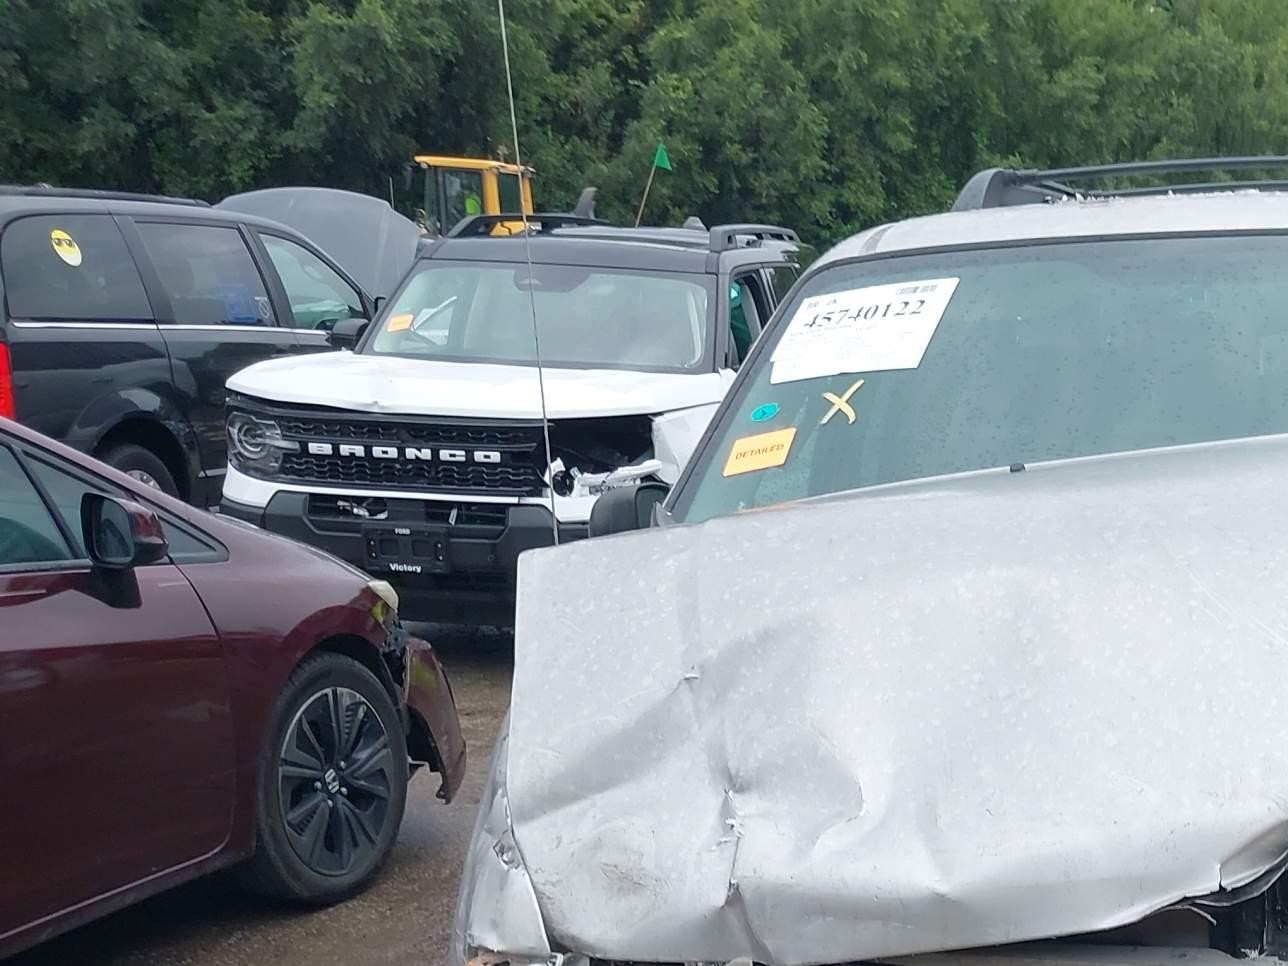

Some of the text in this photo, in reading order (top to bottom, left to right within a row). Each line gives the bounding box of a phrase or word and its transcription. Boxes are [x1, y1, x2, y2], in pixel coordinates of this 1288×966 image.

[803, 299, 926, 328] 45740122
[308, 442, 502, 464] BRONCO
[735, 443, 785, 460] DETAILED
[388, 562, 422, 574] Victory
